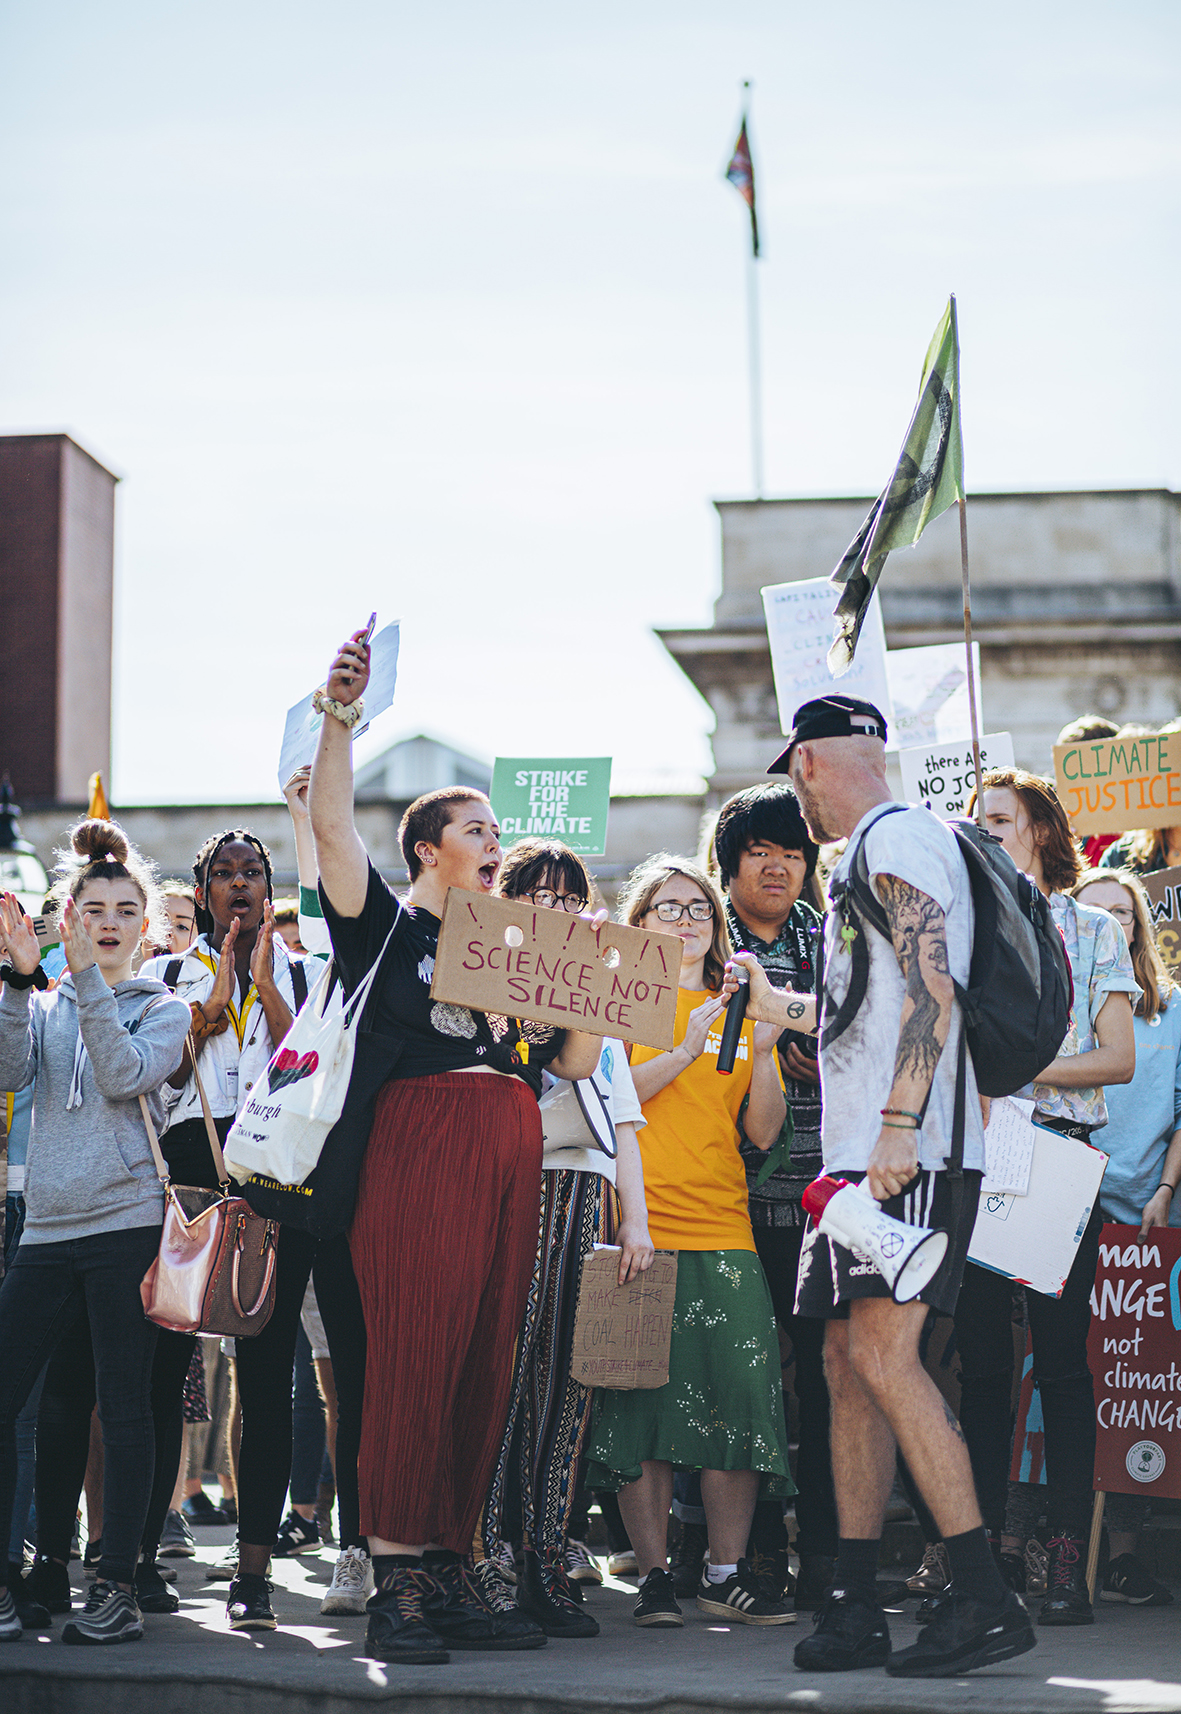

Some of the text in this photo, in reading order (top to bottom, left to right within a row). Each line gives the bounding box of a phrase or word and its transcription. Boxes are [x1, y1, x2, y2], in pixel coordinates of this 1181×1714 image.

[925, 750, 987, 774] there Ae
[1063, 736, 1171, 780] CLIMATE
[515, 770, 588, 786] STRIKE
[918, 766, 998, 798] NO JO
[529, 786, 569, 802] FOR
[945, 800, 964, 812] ON
[1067, 773, 1181, 817] JUSTICE
[528, 802, 569, 817] THE
[501, 817, 592, 834] CLIMATE
[727, 916, 744, 947] LUMIX
[796, 927, 807, 958] LUMIX
[462, 940, 672, 1005] SCIENCE NOT
[507, 977, 634, 1029] SILENCE
[246, 1099, 282, 1122] burgh
[587, 1287, 621, 1313] MAKE
[583, 1314, 670, 1352] COAL HAPPEN
[1103, 1328, 1144, 1356] not
